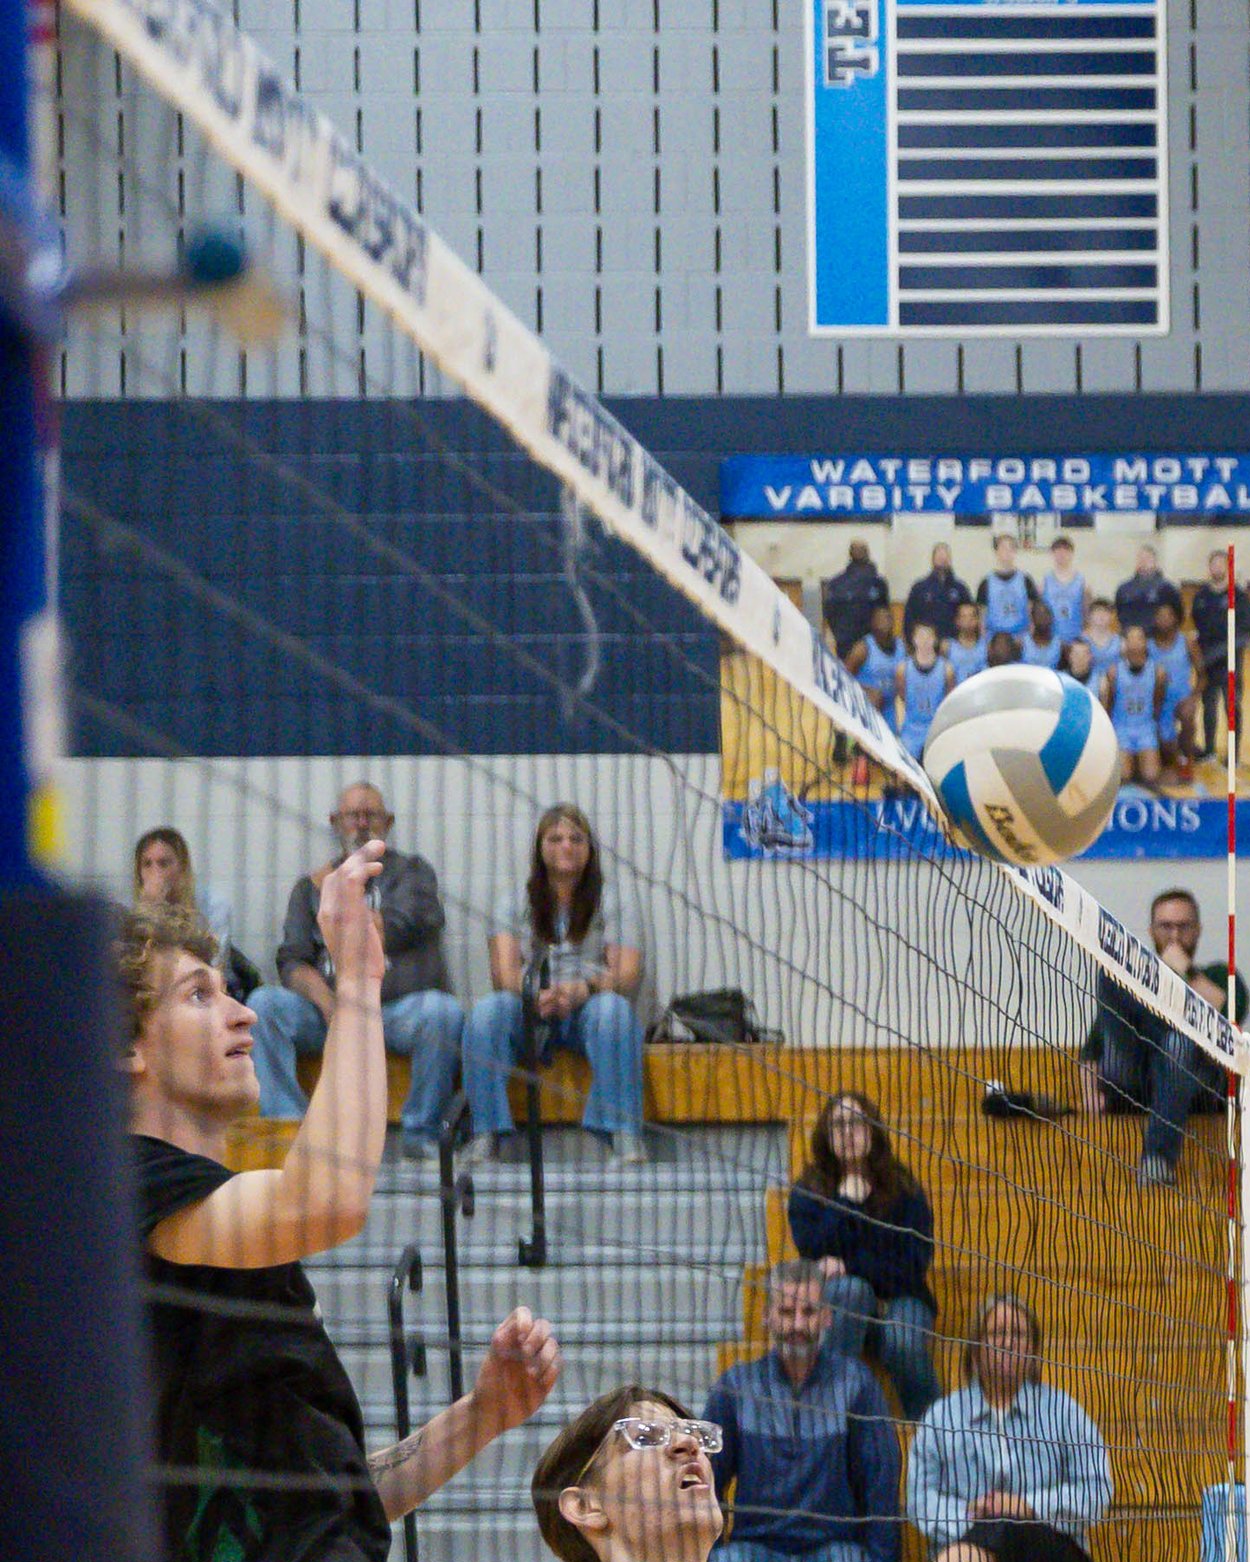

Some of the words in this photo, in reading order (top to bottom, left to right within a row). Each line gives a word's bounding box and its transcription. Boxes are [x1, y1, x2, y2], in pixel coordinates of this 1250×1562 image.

[810, 457, 1092, 484] WATERFORD
[1113, 457, 1240, 484] MOTT
[763, 484, 963, 511] VARSITY
